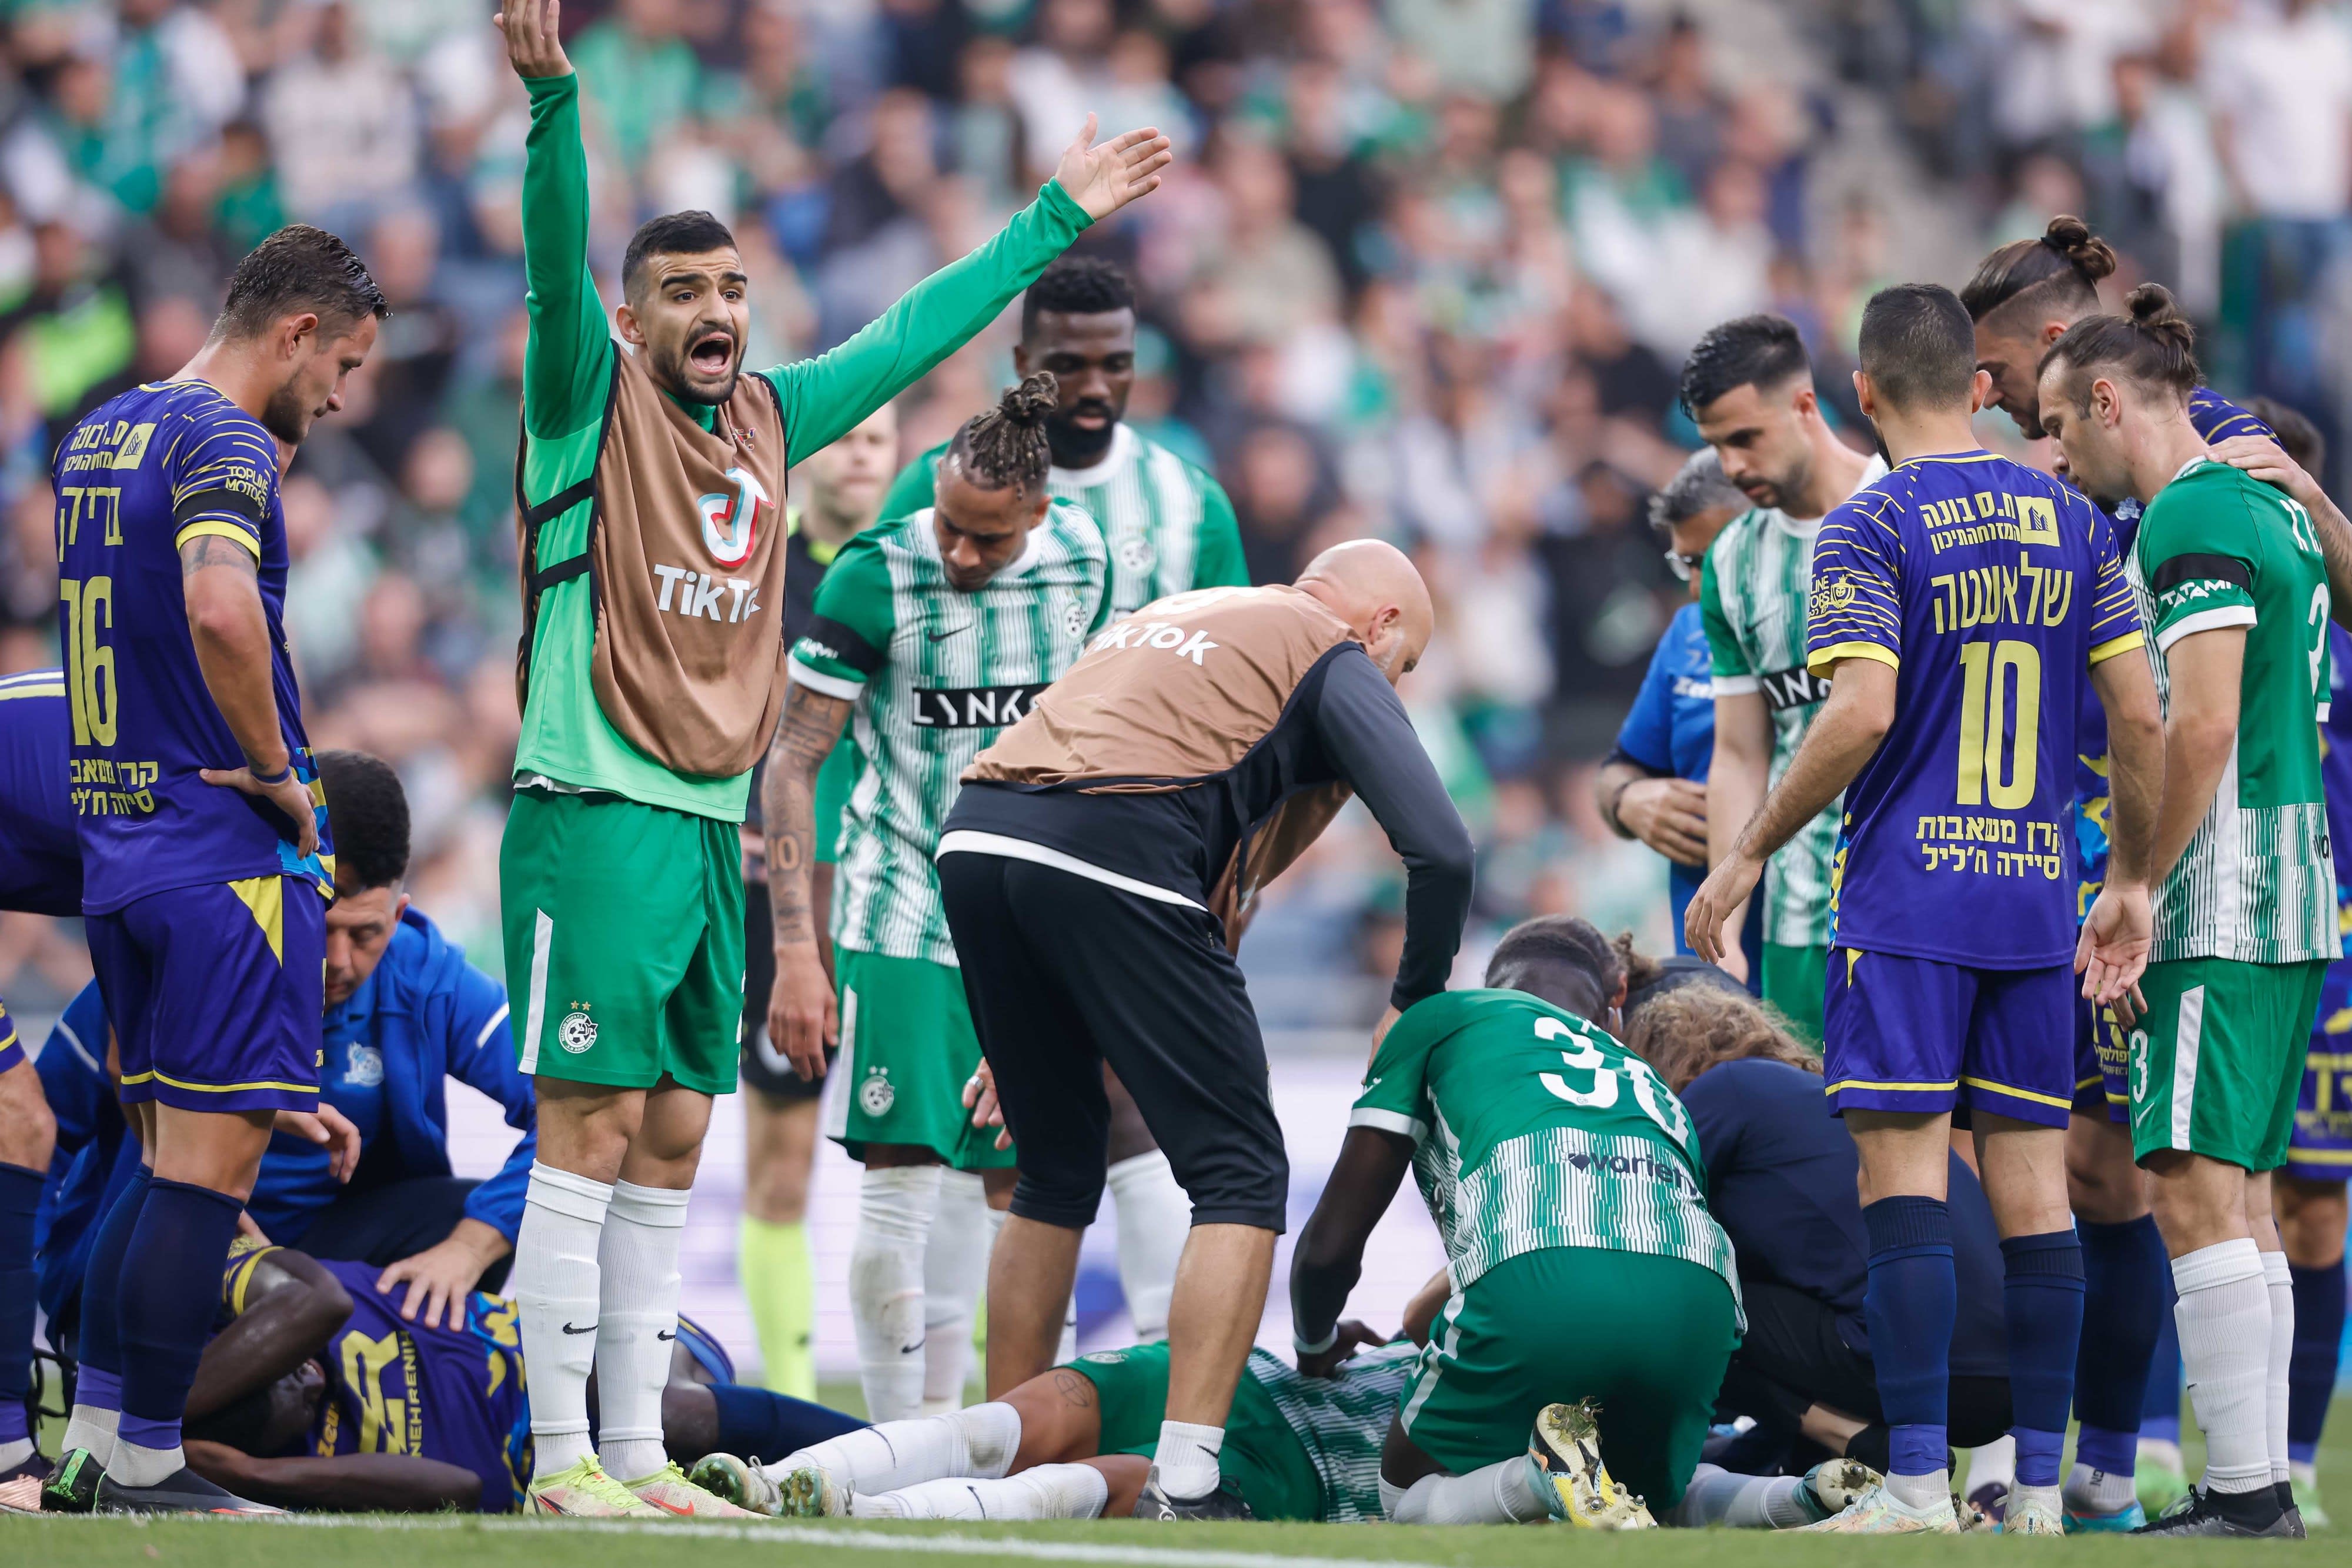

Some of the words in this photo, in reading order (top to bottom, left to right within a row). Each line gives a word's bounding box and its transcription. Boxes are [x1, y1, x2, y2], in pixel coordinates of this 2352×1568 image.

[59, 487, 124, 562] בריק
[1919, 497, 1977, 529] בונה
[654, 564, 761, 623] TikTo
[1930, 551, 2073, 634] שלאעטה
[2160, 579, 2231, 608] TATAMI
[60, 576, 118, 747] 16
[1957, 640, 2041, 810] 10
[1916, 815, 2017, 844] משאבות
[1997, 851, 2060, 880] סיידה
[1534, 1017, 1689, 1149] 30
[2131, 1029, 2148, 1104] 3
[1590, 1151, 1698, 1196] variety
